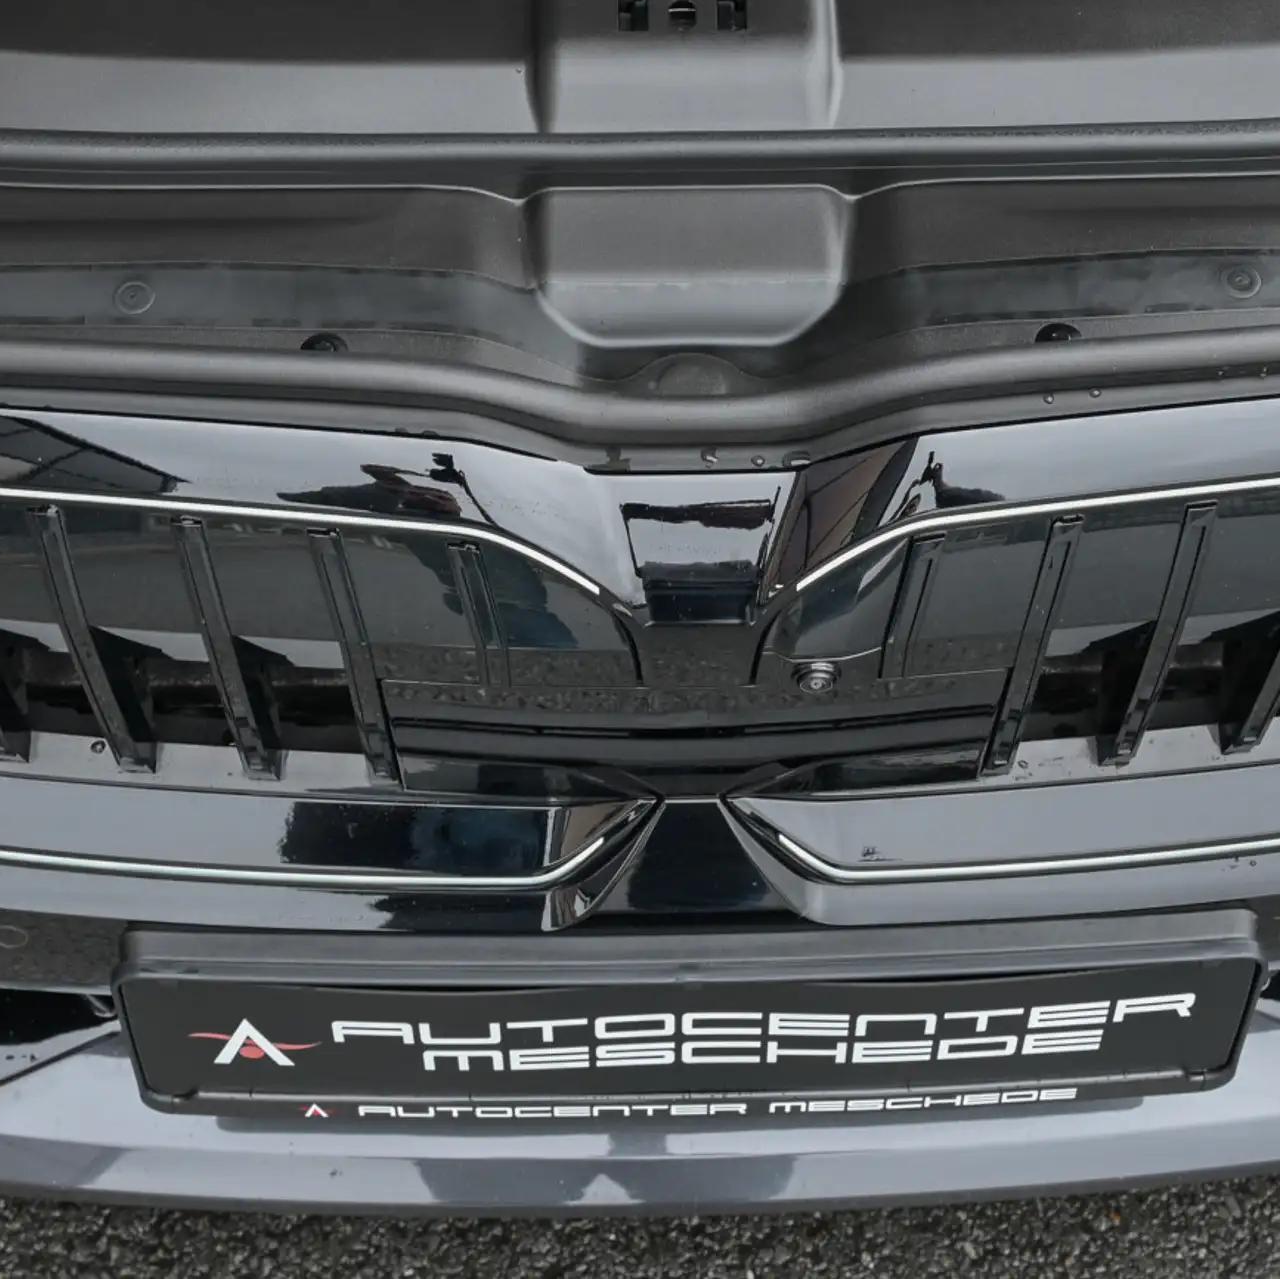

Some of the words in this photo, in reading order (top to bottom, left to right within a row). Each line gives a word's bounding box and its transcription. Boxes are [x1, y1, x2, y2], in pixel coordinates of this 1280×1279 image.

[331, 992, 1197, 1045] AUTOCENTER
[422, 1028, 1104, 1072] MESCHEDE
[358, 1103, 747, 1118] AUTOCENTER
[769, 1088, 1078, 1114] MESCHEDE
